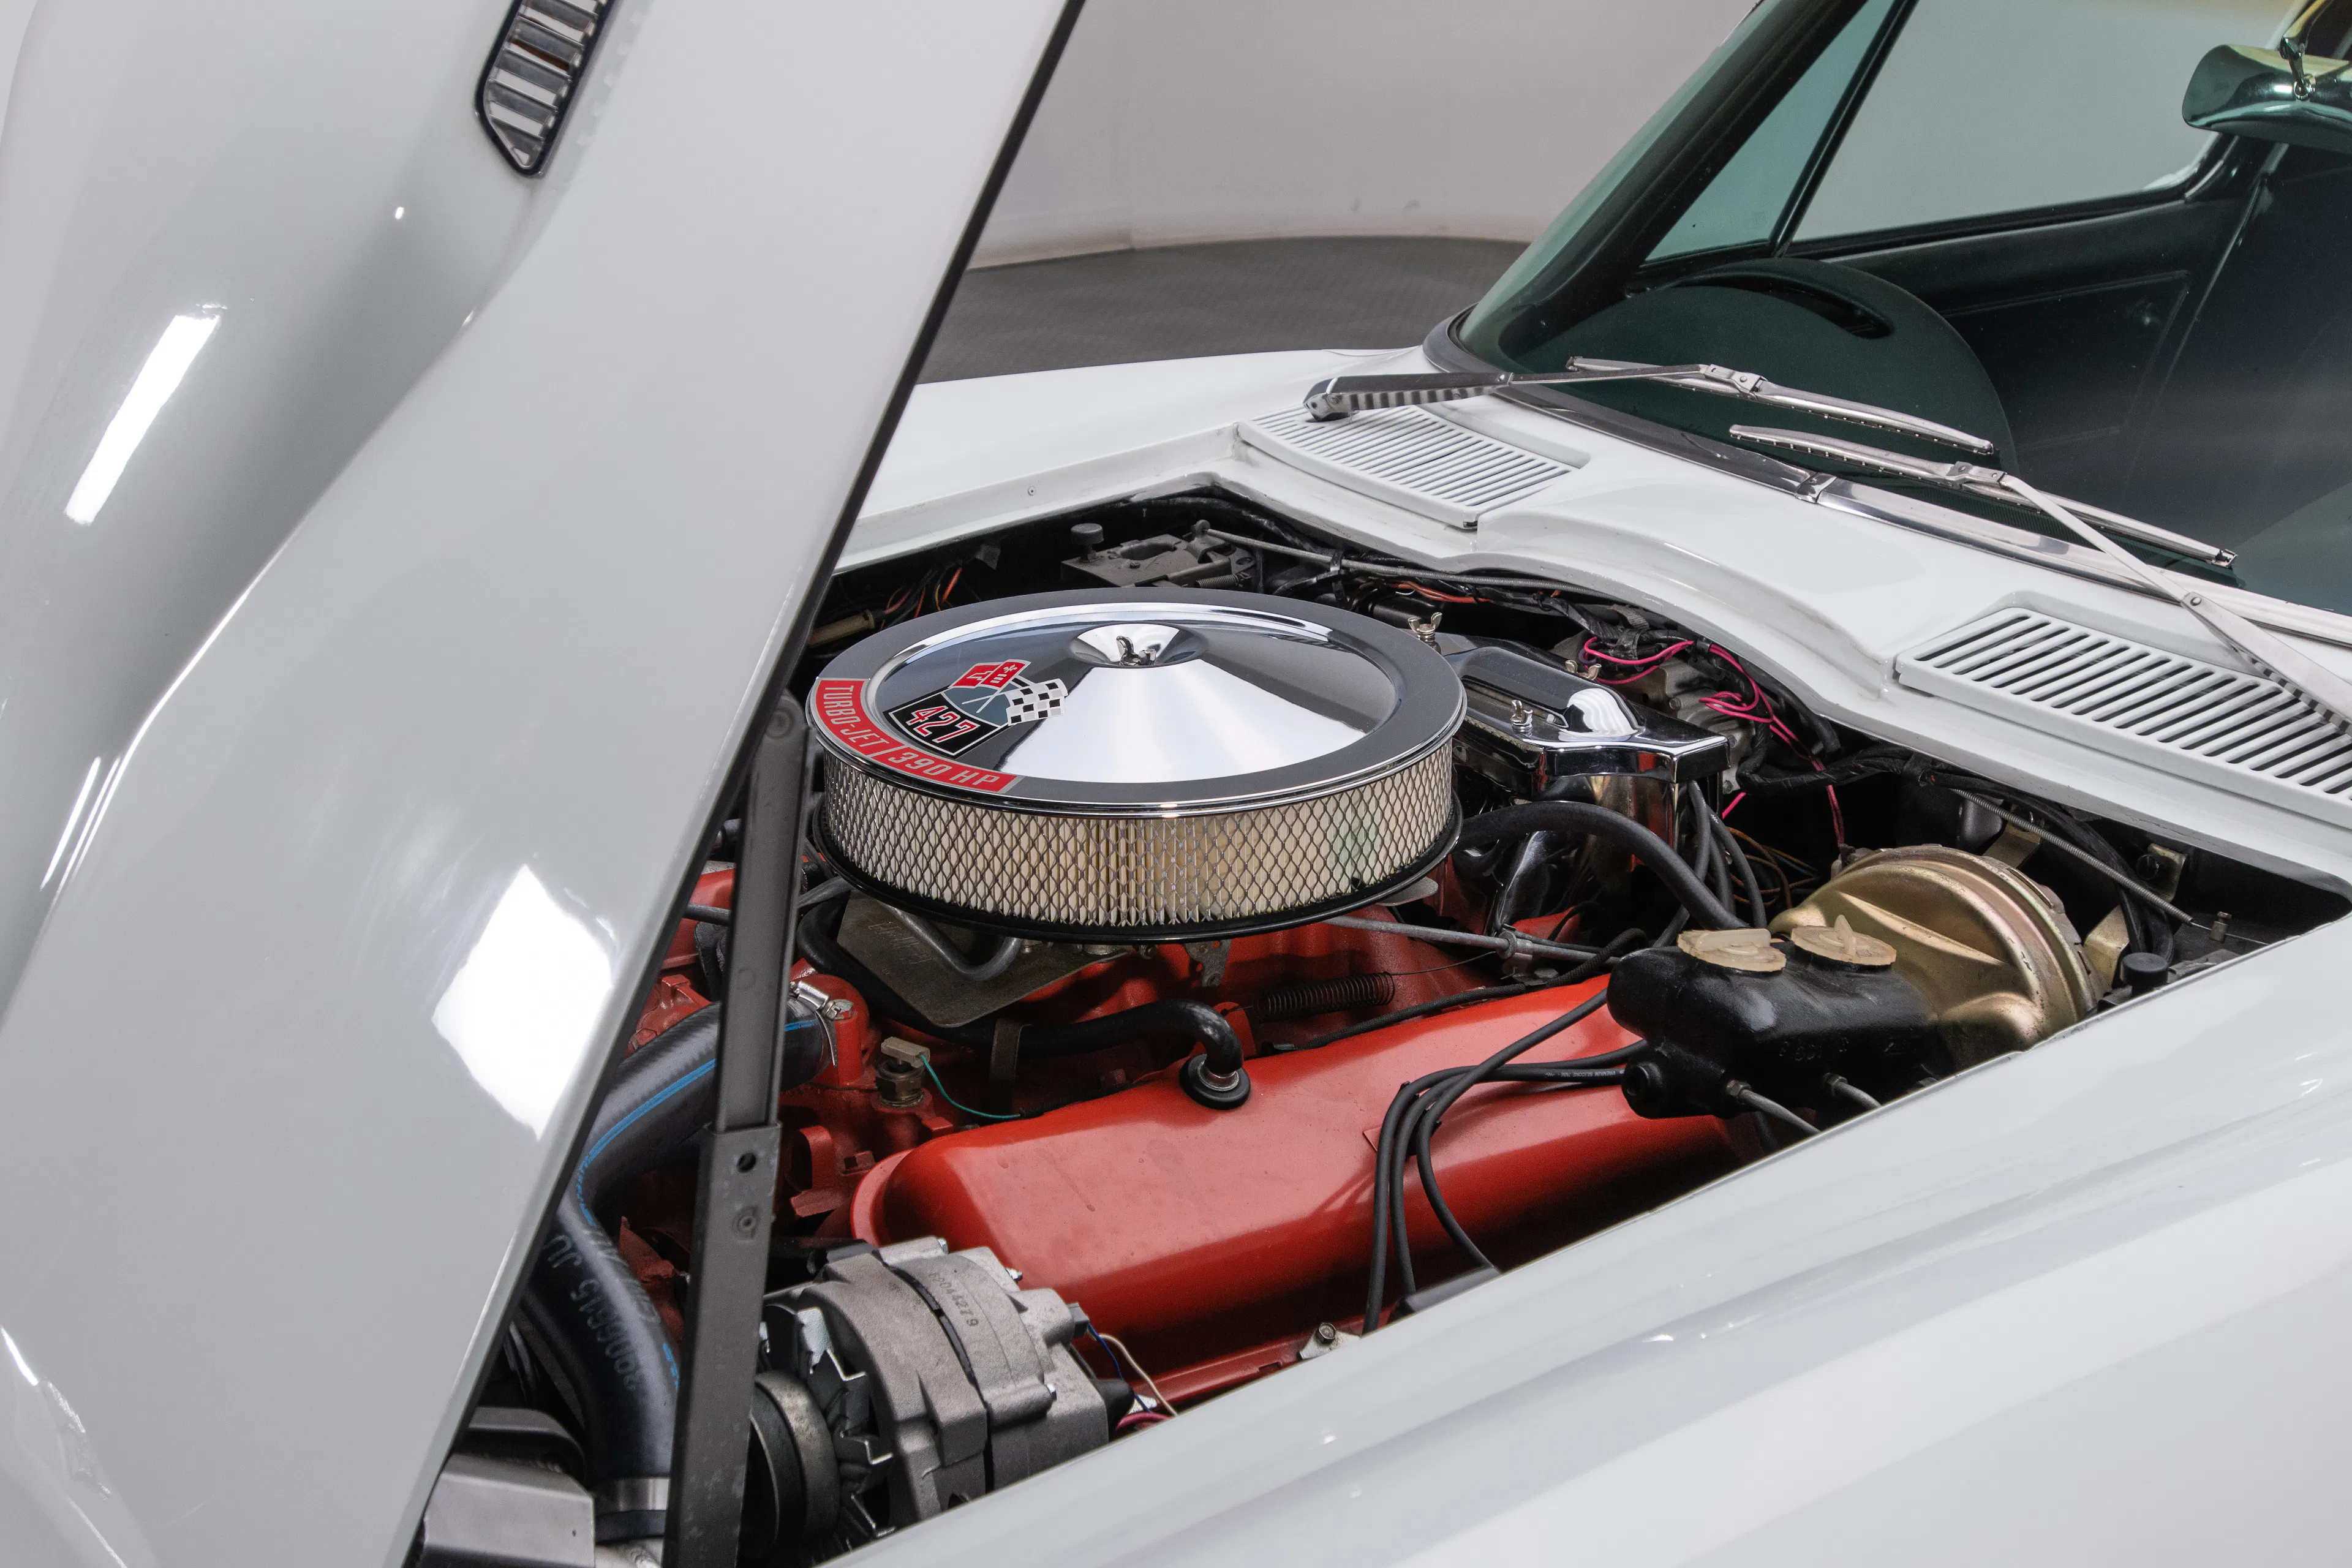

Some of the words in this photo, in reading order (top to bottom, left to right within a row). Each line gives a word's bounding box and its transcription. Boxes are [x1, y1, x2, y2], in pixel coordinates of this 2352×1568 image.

[823, 685, 890, 747] TURBO-JET
[889, 752, 949, 776] 390
[950, 770, 1000, 786] HP
[907, 706, 980, 744] 427
